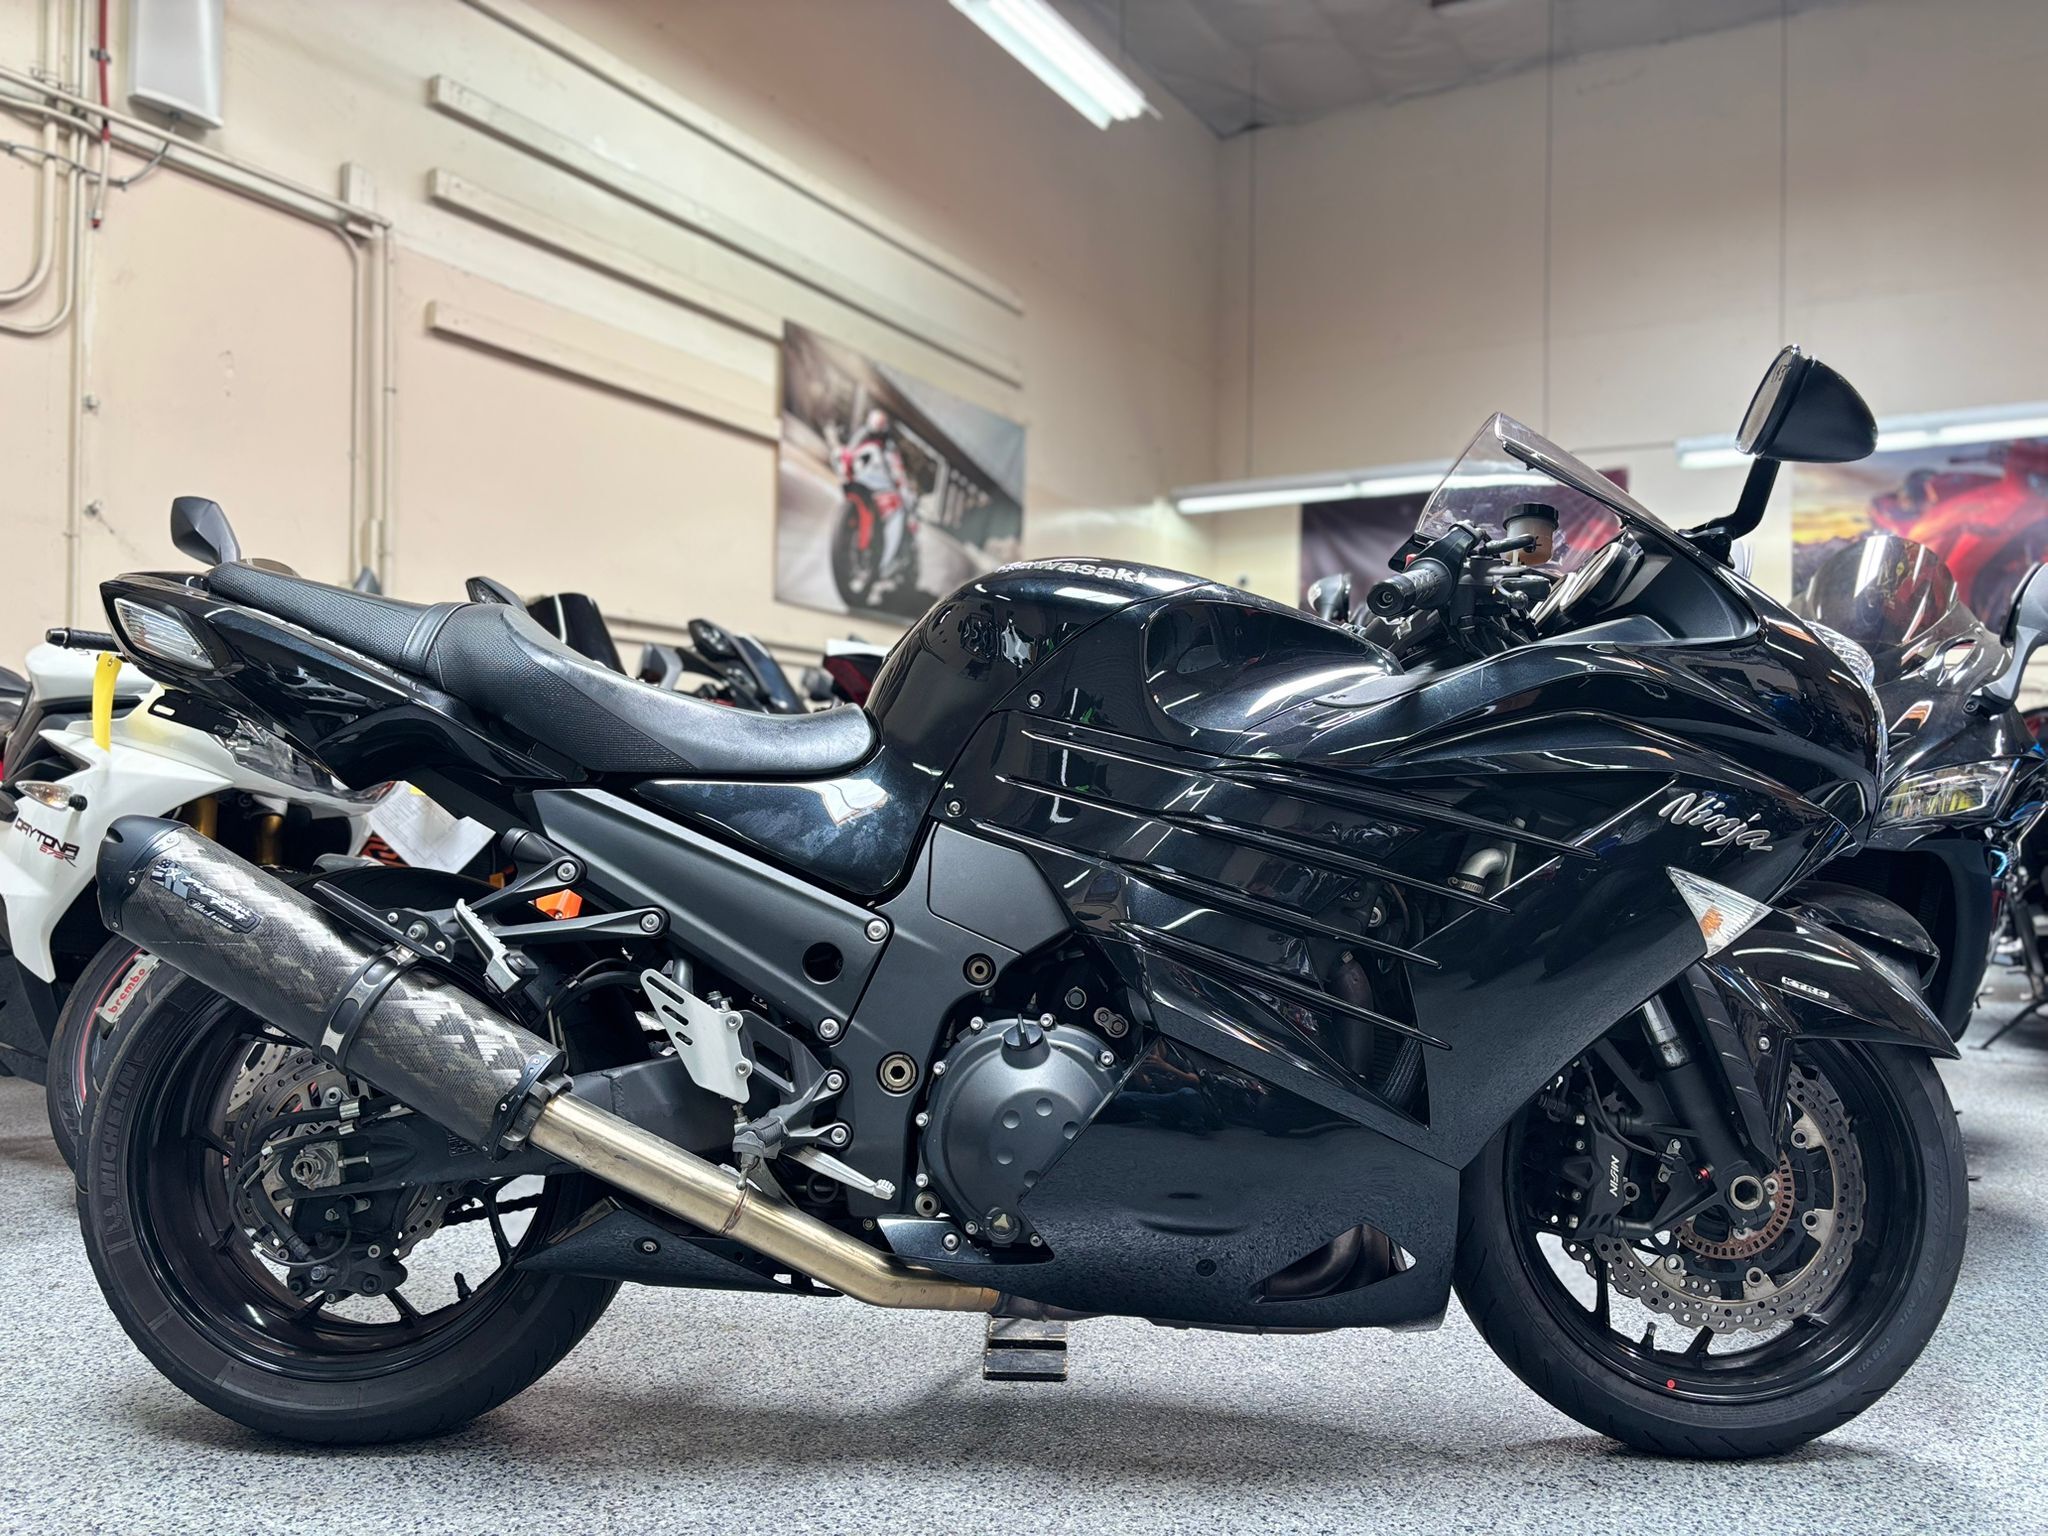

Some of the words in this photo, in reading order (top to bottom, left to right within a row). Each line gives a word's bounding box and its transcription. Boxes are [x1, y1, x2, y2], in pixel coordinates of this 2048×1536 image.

[994, 560, 1147, 585] Kawasaki
[15, 817, 80, 860] DAYTONA
[1658, 792, 1774, 852] Ninja
[107, 968, 146, 1013] brembo
[101, 1063, 139, 1197] MICHELIN
[1609, 1154, 1620, 1198] NISSIN
